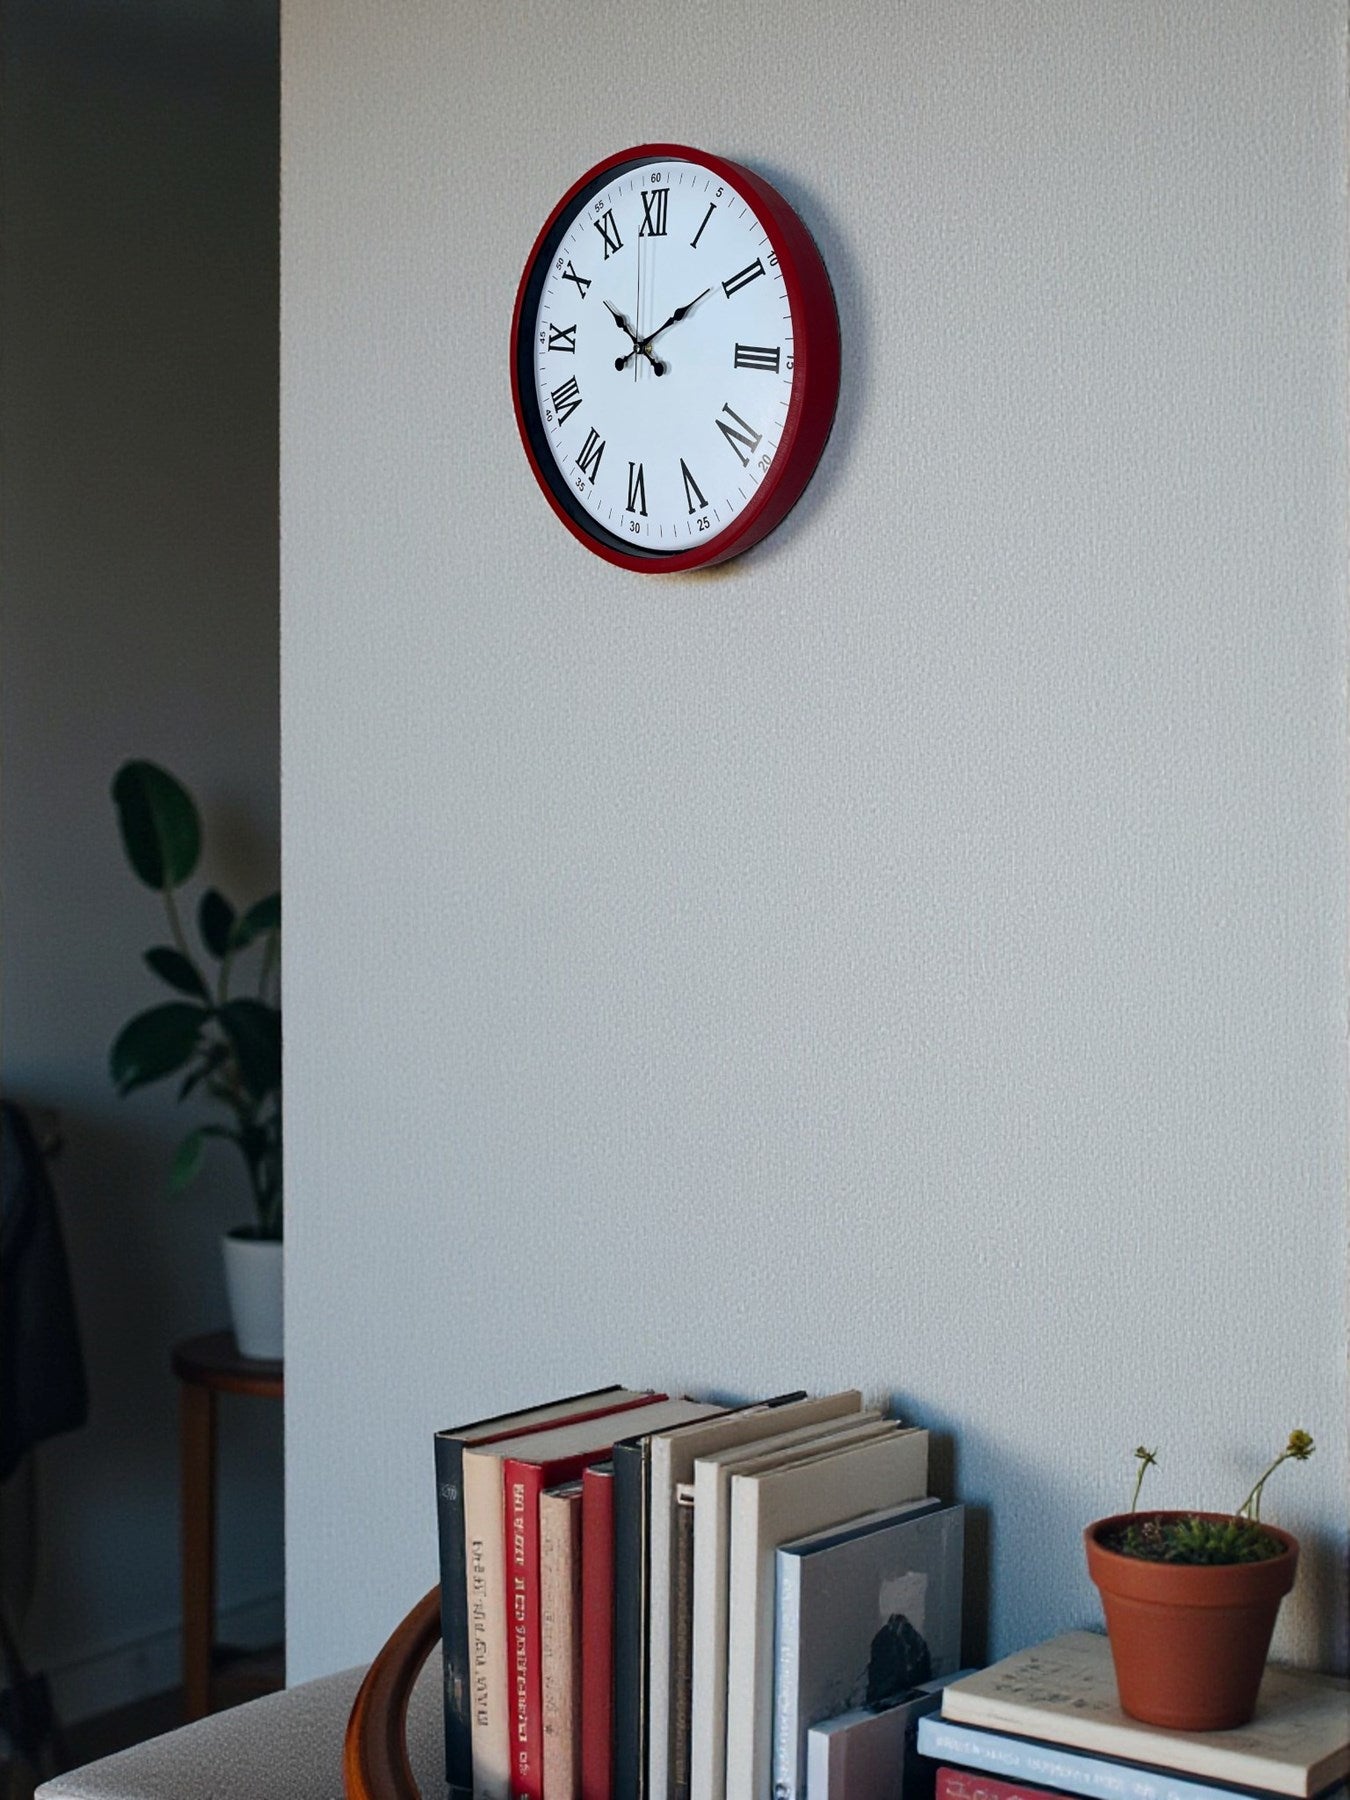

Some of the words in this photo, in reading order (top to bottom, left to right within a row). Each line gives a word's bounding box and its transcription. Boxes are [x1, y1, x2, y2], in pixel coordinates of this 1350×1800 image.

[650, 172, 662, 184] 60
[715, 187, 724, 198] 5
[593, 199, 605, 213] 55
[638, 187, 670, 238] XII
[593, 208, 624, 260] XI
[690, 202, 717, 249] I
[555, 257, 564, 271] 50
[767, 250, 779, 267] 10
[561, 260, 592, 299] X
[721, 256, 766, 300] II
[539, 331, 546, 344] 45
[548, 323, 577, 355] IX
[734, 342, 781, 374] III
[545, 409, 553, 422] 40
[551, 375, 583, 427] VIII
[714, 402, 763, 468] IV
[575, 426, 606, 486] VII
[758, 454, 772, 473] 20
[575, 477, 586, 492] 35
[625, 461, 649, 517] VI
[679, 457, 709, 515] V
[629, 520, 641, 534] 30
[696, 517, 711, 532] 25
